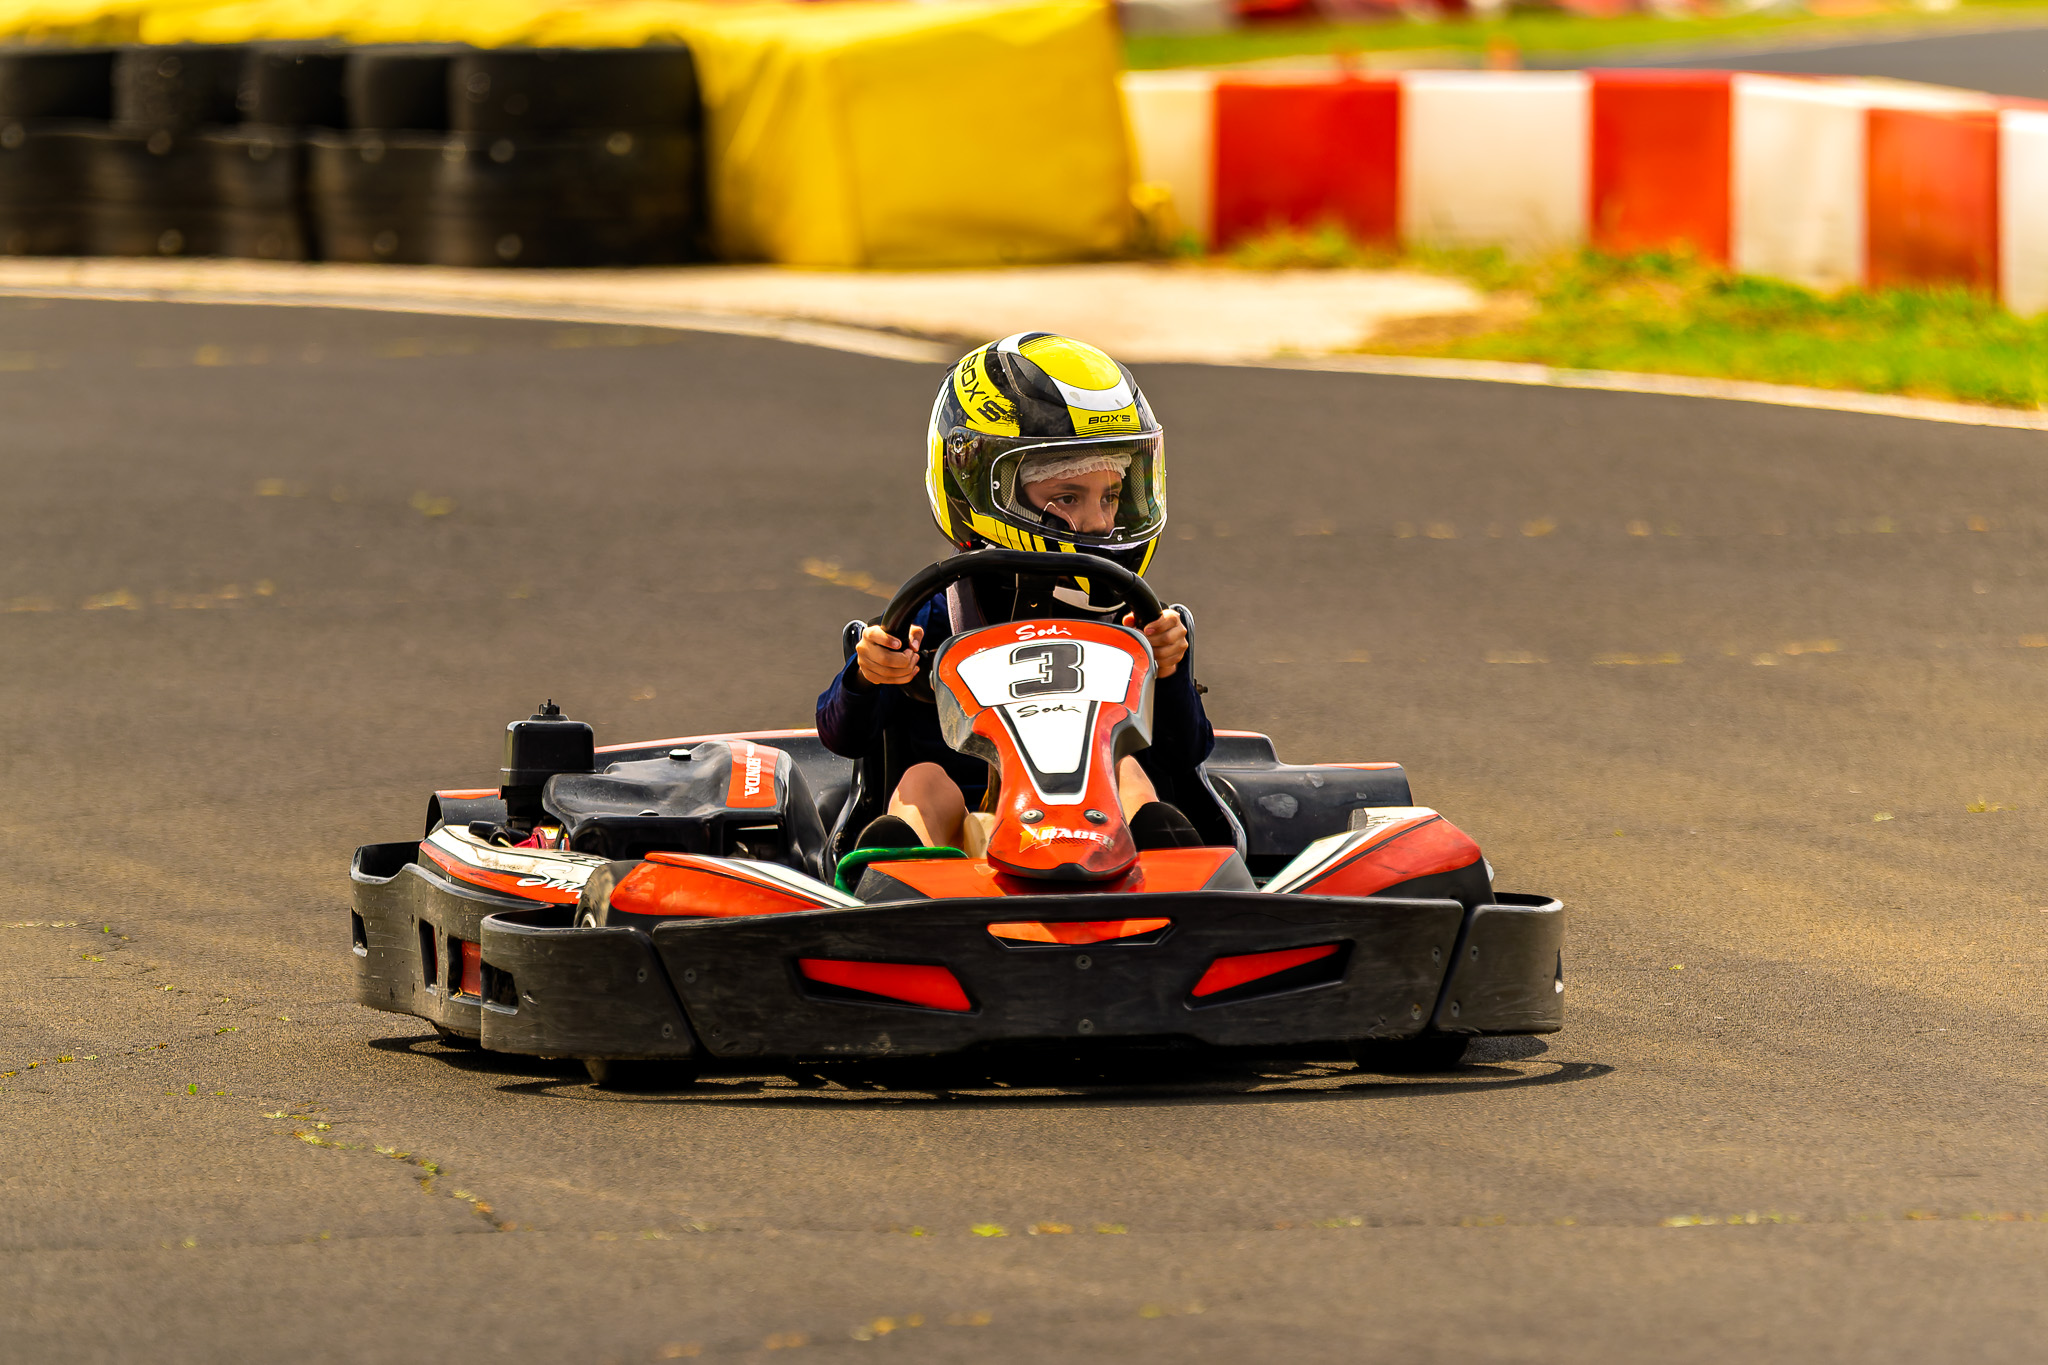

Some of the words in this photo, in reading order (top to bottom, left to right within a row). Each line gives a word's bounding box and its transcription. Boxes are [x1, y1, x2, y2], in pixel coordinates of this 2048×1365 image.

[961, 352, 1008, 423] BOX'S
[1088, 414, 1131, 425] BOX'S
[1015, 624, 1073, 641] Sodi
[1008, 641, 1085, 699] 3
[1016, 704, 1082, 718] Sodi
[744, 757, 762, 799] HONDA
